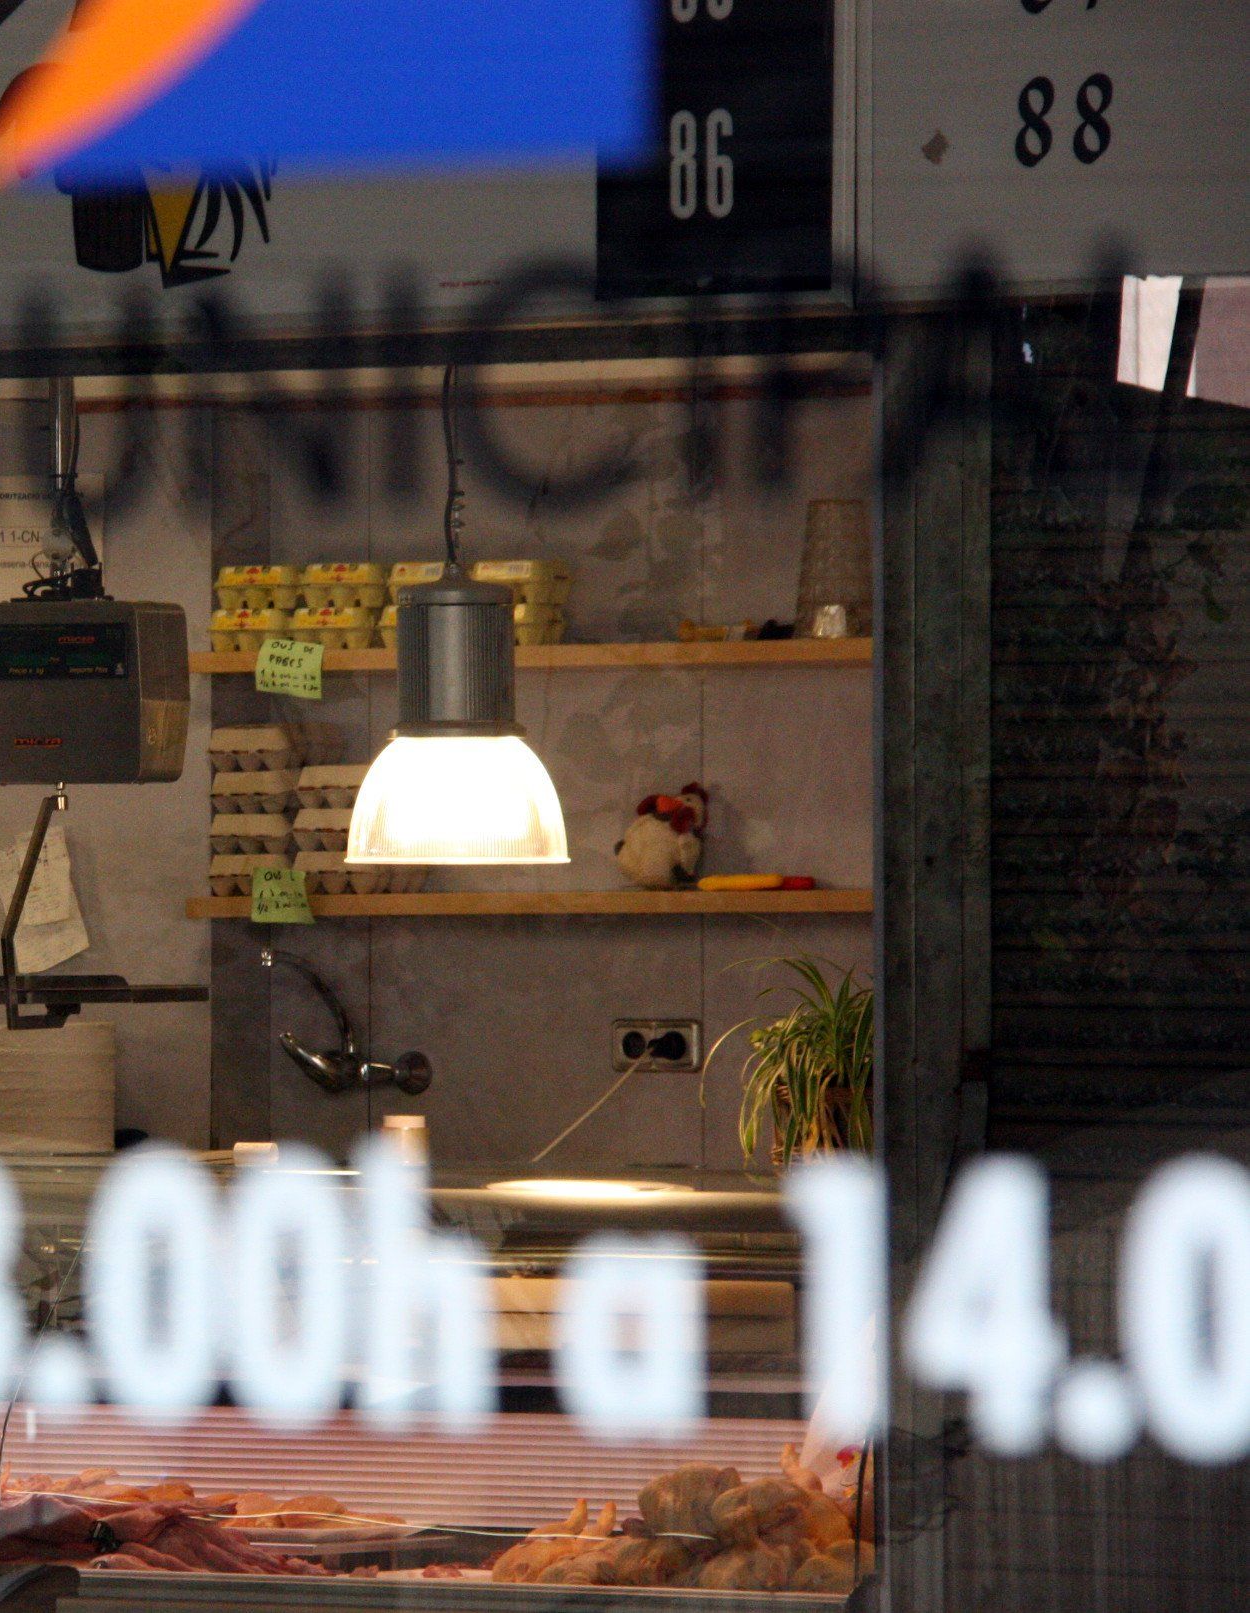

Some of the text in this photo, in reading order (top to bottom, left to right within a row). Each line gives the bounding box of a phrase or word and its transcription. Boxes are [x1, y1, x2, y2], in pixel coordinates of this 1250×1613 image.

[669, 107, 735, 220] 86
[1014, 72, 1114, 168] 88
[556, 1234, 709, 1440] a
